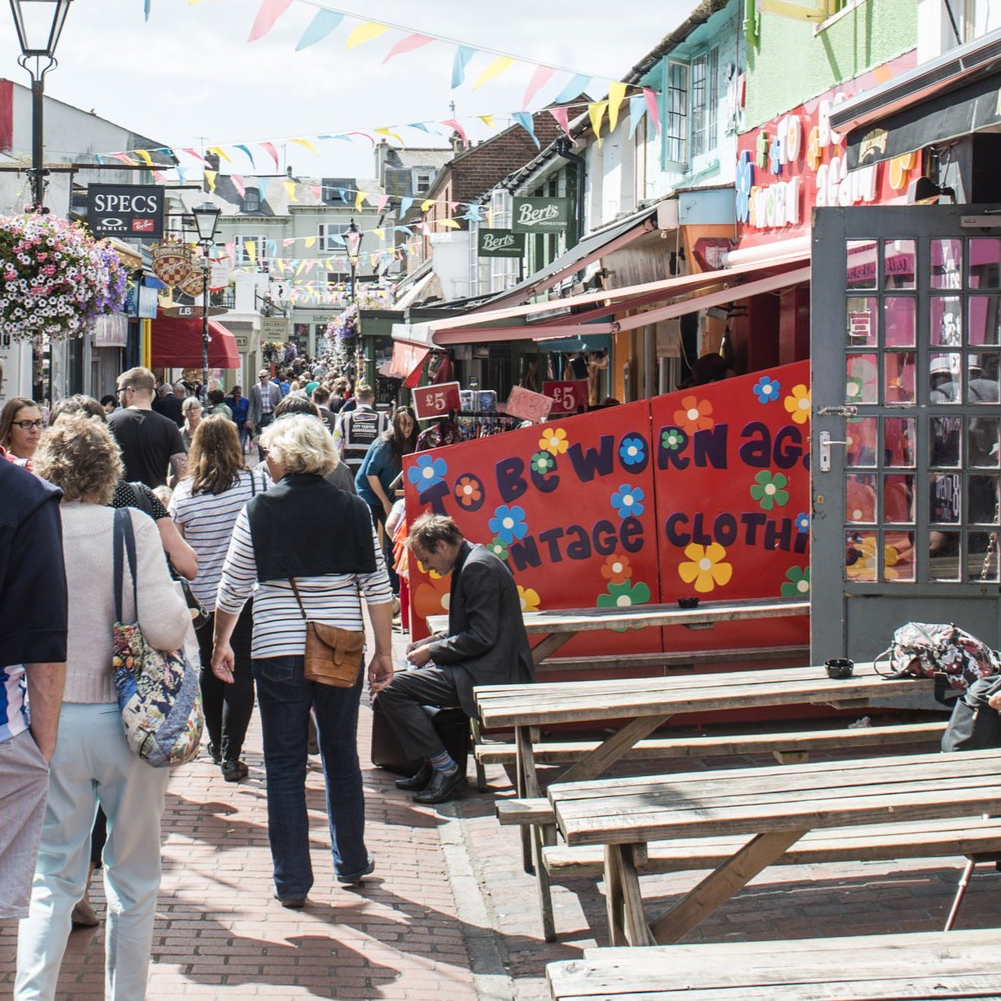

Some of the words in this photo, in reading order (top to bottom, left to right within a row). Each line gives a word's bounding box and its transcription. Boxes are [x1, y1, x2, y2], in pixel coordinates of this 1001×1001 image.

[777, 114, 802, 165] TO
[94, 194, 158, 213] SPECS
[518, 203, 560, 223] Bert's
[482, 233, 515, 250] Bert's
[425, 392, 446, 411] £5
[552, 386, 575, 410] £5
[419, 472, 487, 518] TO
[566, 422, 729, 484] WORN
[664, 510, 810, 555] CLOTHi
